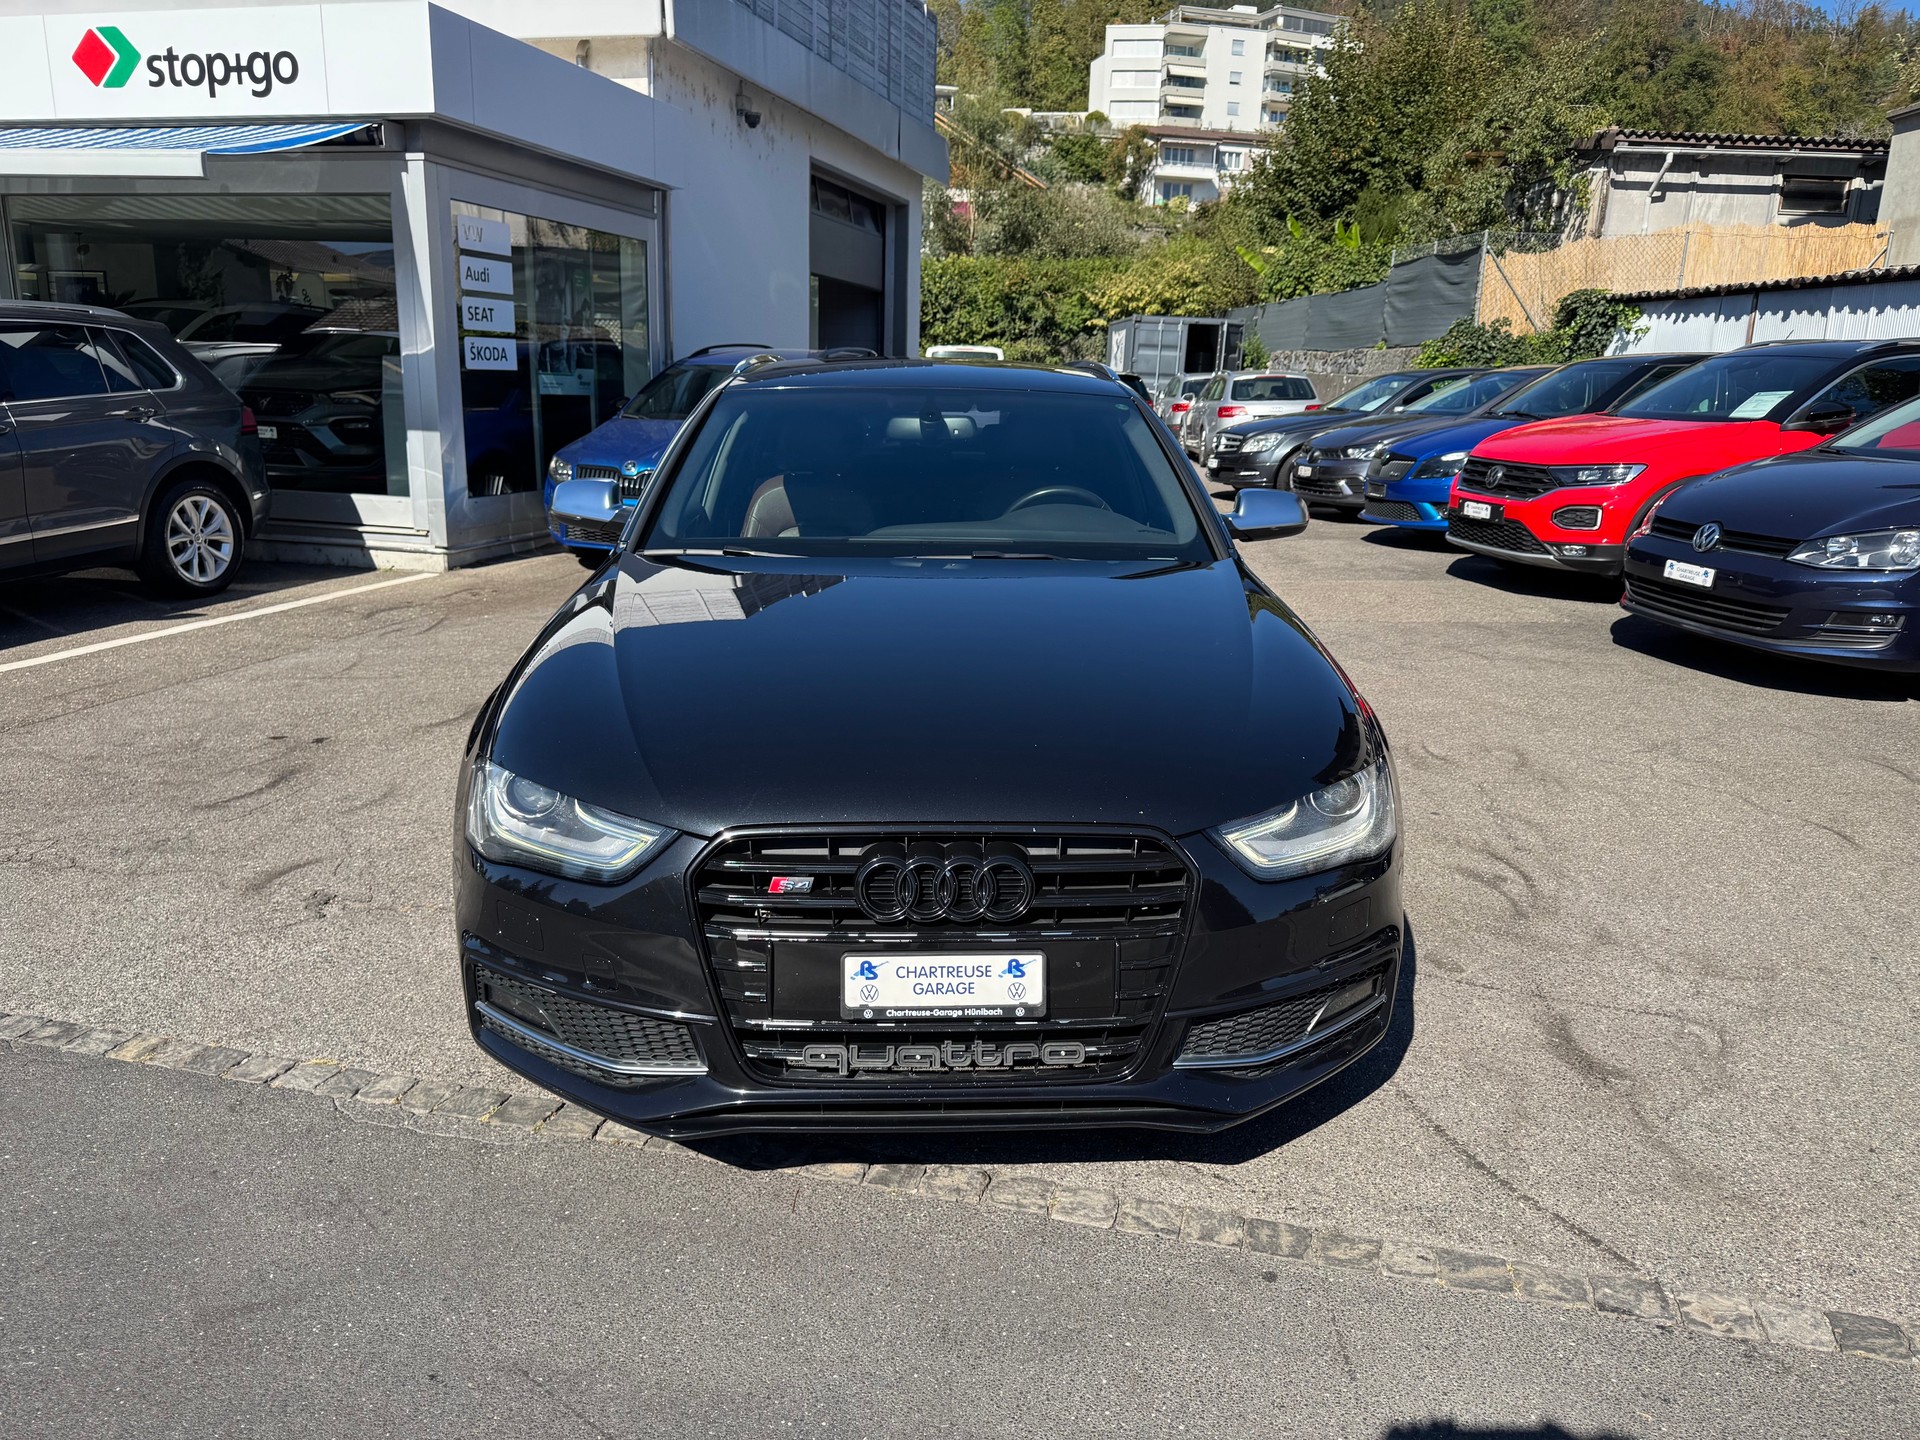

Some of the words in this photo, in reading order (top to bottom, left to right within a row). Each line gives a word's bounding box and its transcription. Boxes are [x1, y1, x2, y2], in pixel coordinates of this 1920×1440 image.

[146, 45, 299, 98] stop+go
[465, 266, 490, 283] Audi
[467, 306, 495, 322] SEAT
[470, 342, 508, 362] ŠKODA
[778, 880, 811, 891] S4
[895, 965, 992, 979] CHARTREUSE
[913, 982, 975, 996] GARAGE
[886, 1008, 962, 1018] Chartreuse-Garage
[964, 1007, 1003, 1017] Hünibach
[802, 1040, 1086, 1075] quattro
